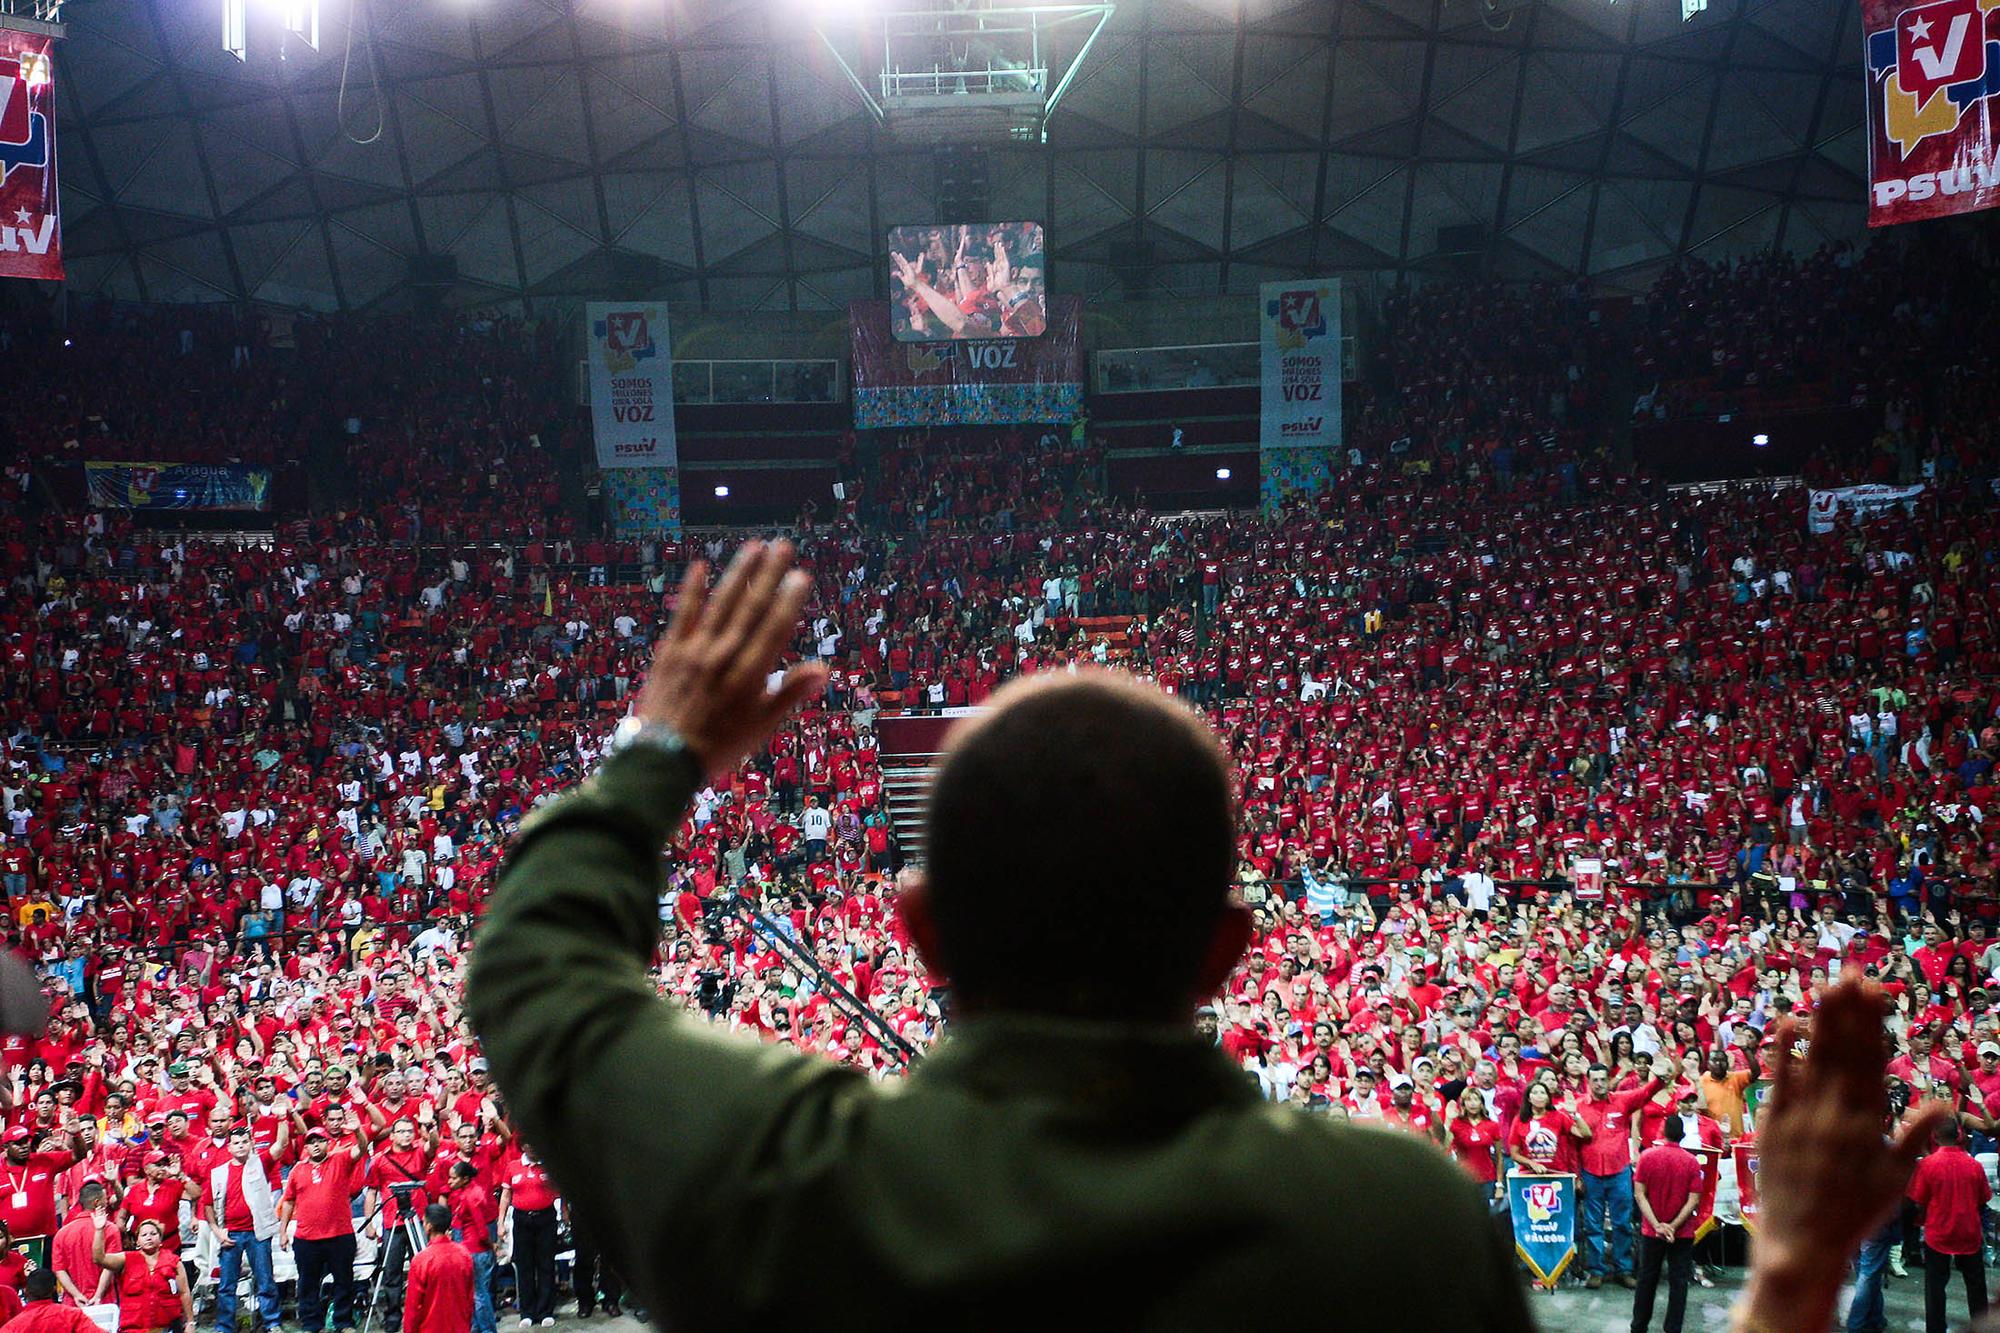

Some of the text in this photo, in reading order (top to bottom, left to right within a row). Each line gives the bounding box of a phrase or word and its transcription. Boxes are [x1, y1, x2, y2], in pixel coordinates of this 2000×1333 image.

[968, 345, 1018, 369] VOZ
[1282, 356, 1322, 368] SOMOS
[611, 378, 653, 389] SOMOS
[1282, 384, 1322, 401] VOZ
[613, 405, 655, 423] VOZ
[175, 465, 227, 477] Aragua
[811, 815, 822, 826] 10
